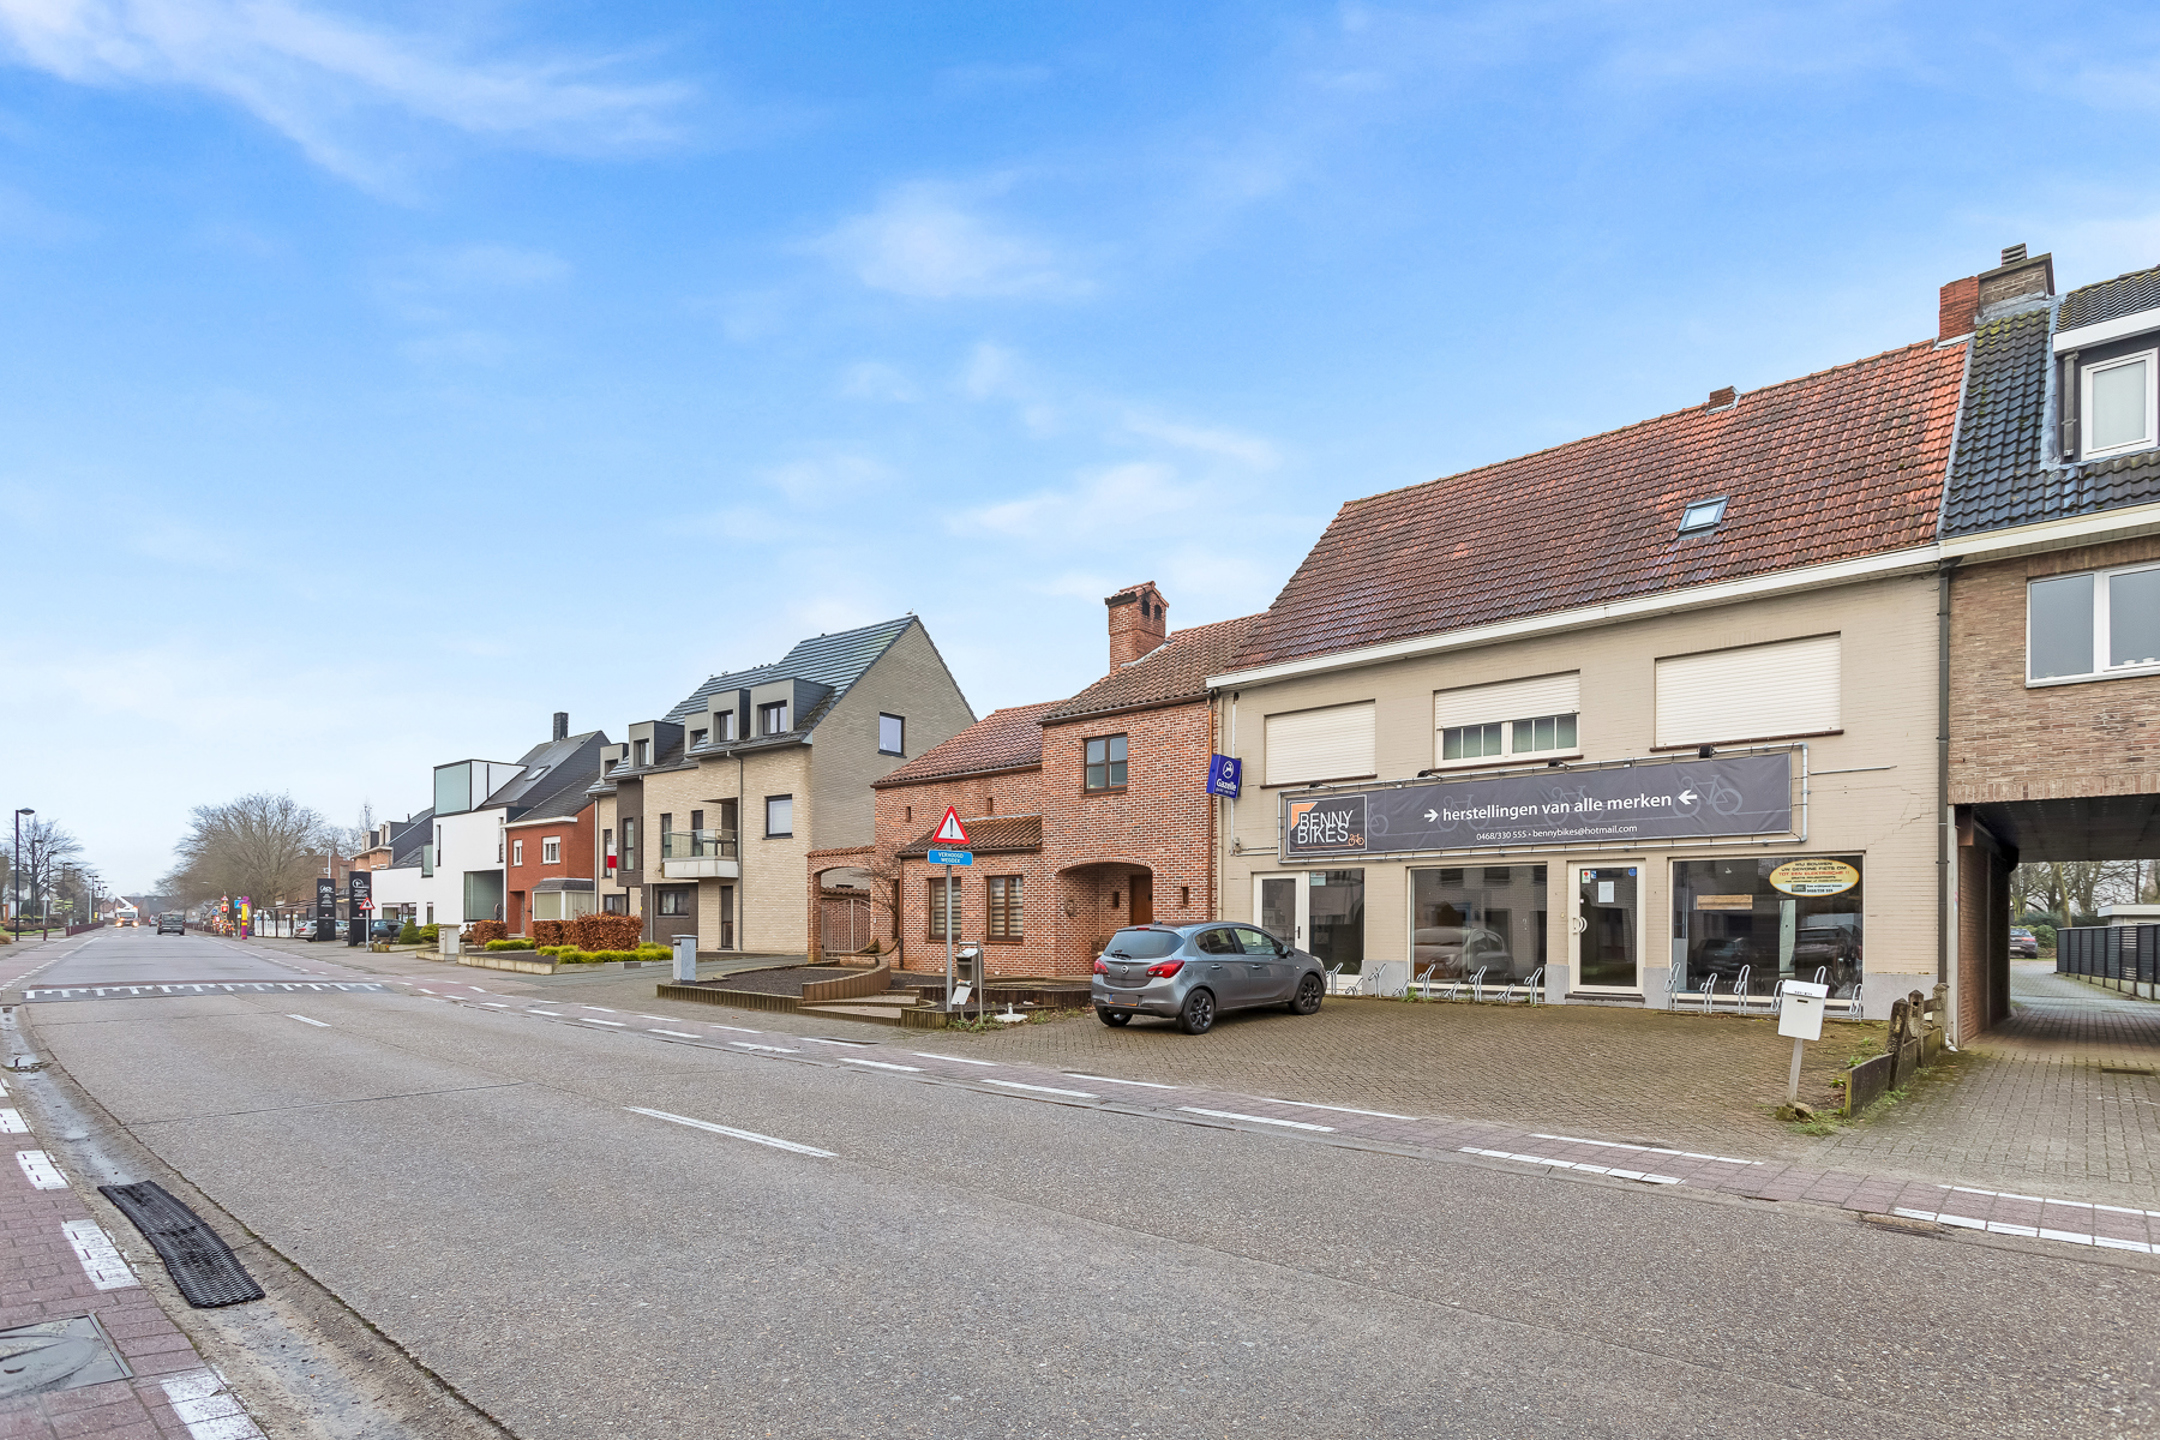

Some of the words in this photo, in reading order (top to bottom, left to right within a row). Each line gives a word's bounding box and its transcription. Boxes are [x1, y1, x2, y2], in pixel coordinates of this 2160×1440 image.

[1443, 805, 1537, 820] herstellingen
[1541, 802, 1570, 814] van
[1574, 798, 1602, 812] alle
[1607, 793, 1671, 809] merken
[1300, 810, 1353, 829] BENNY
[1297, 823, 1349, 844] BIKES
[1476, 831, 1512, 841] 0468/330
[1512, 830, 1527, 839] 555
[1533, 825, 1638, 838] bennybikes@hotmail.com
